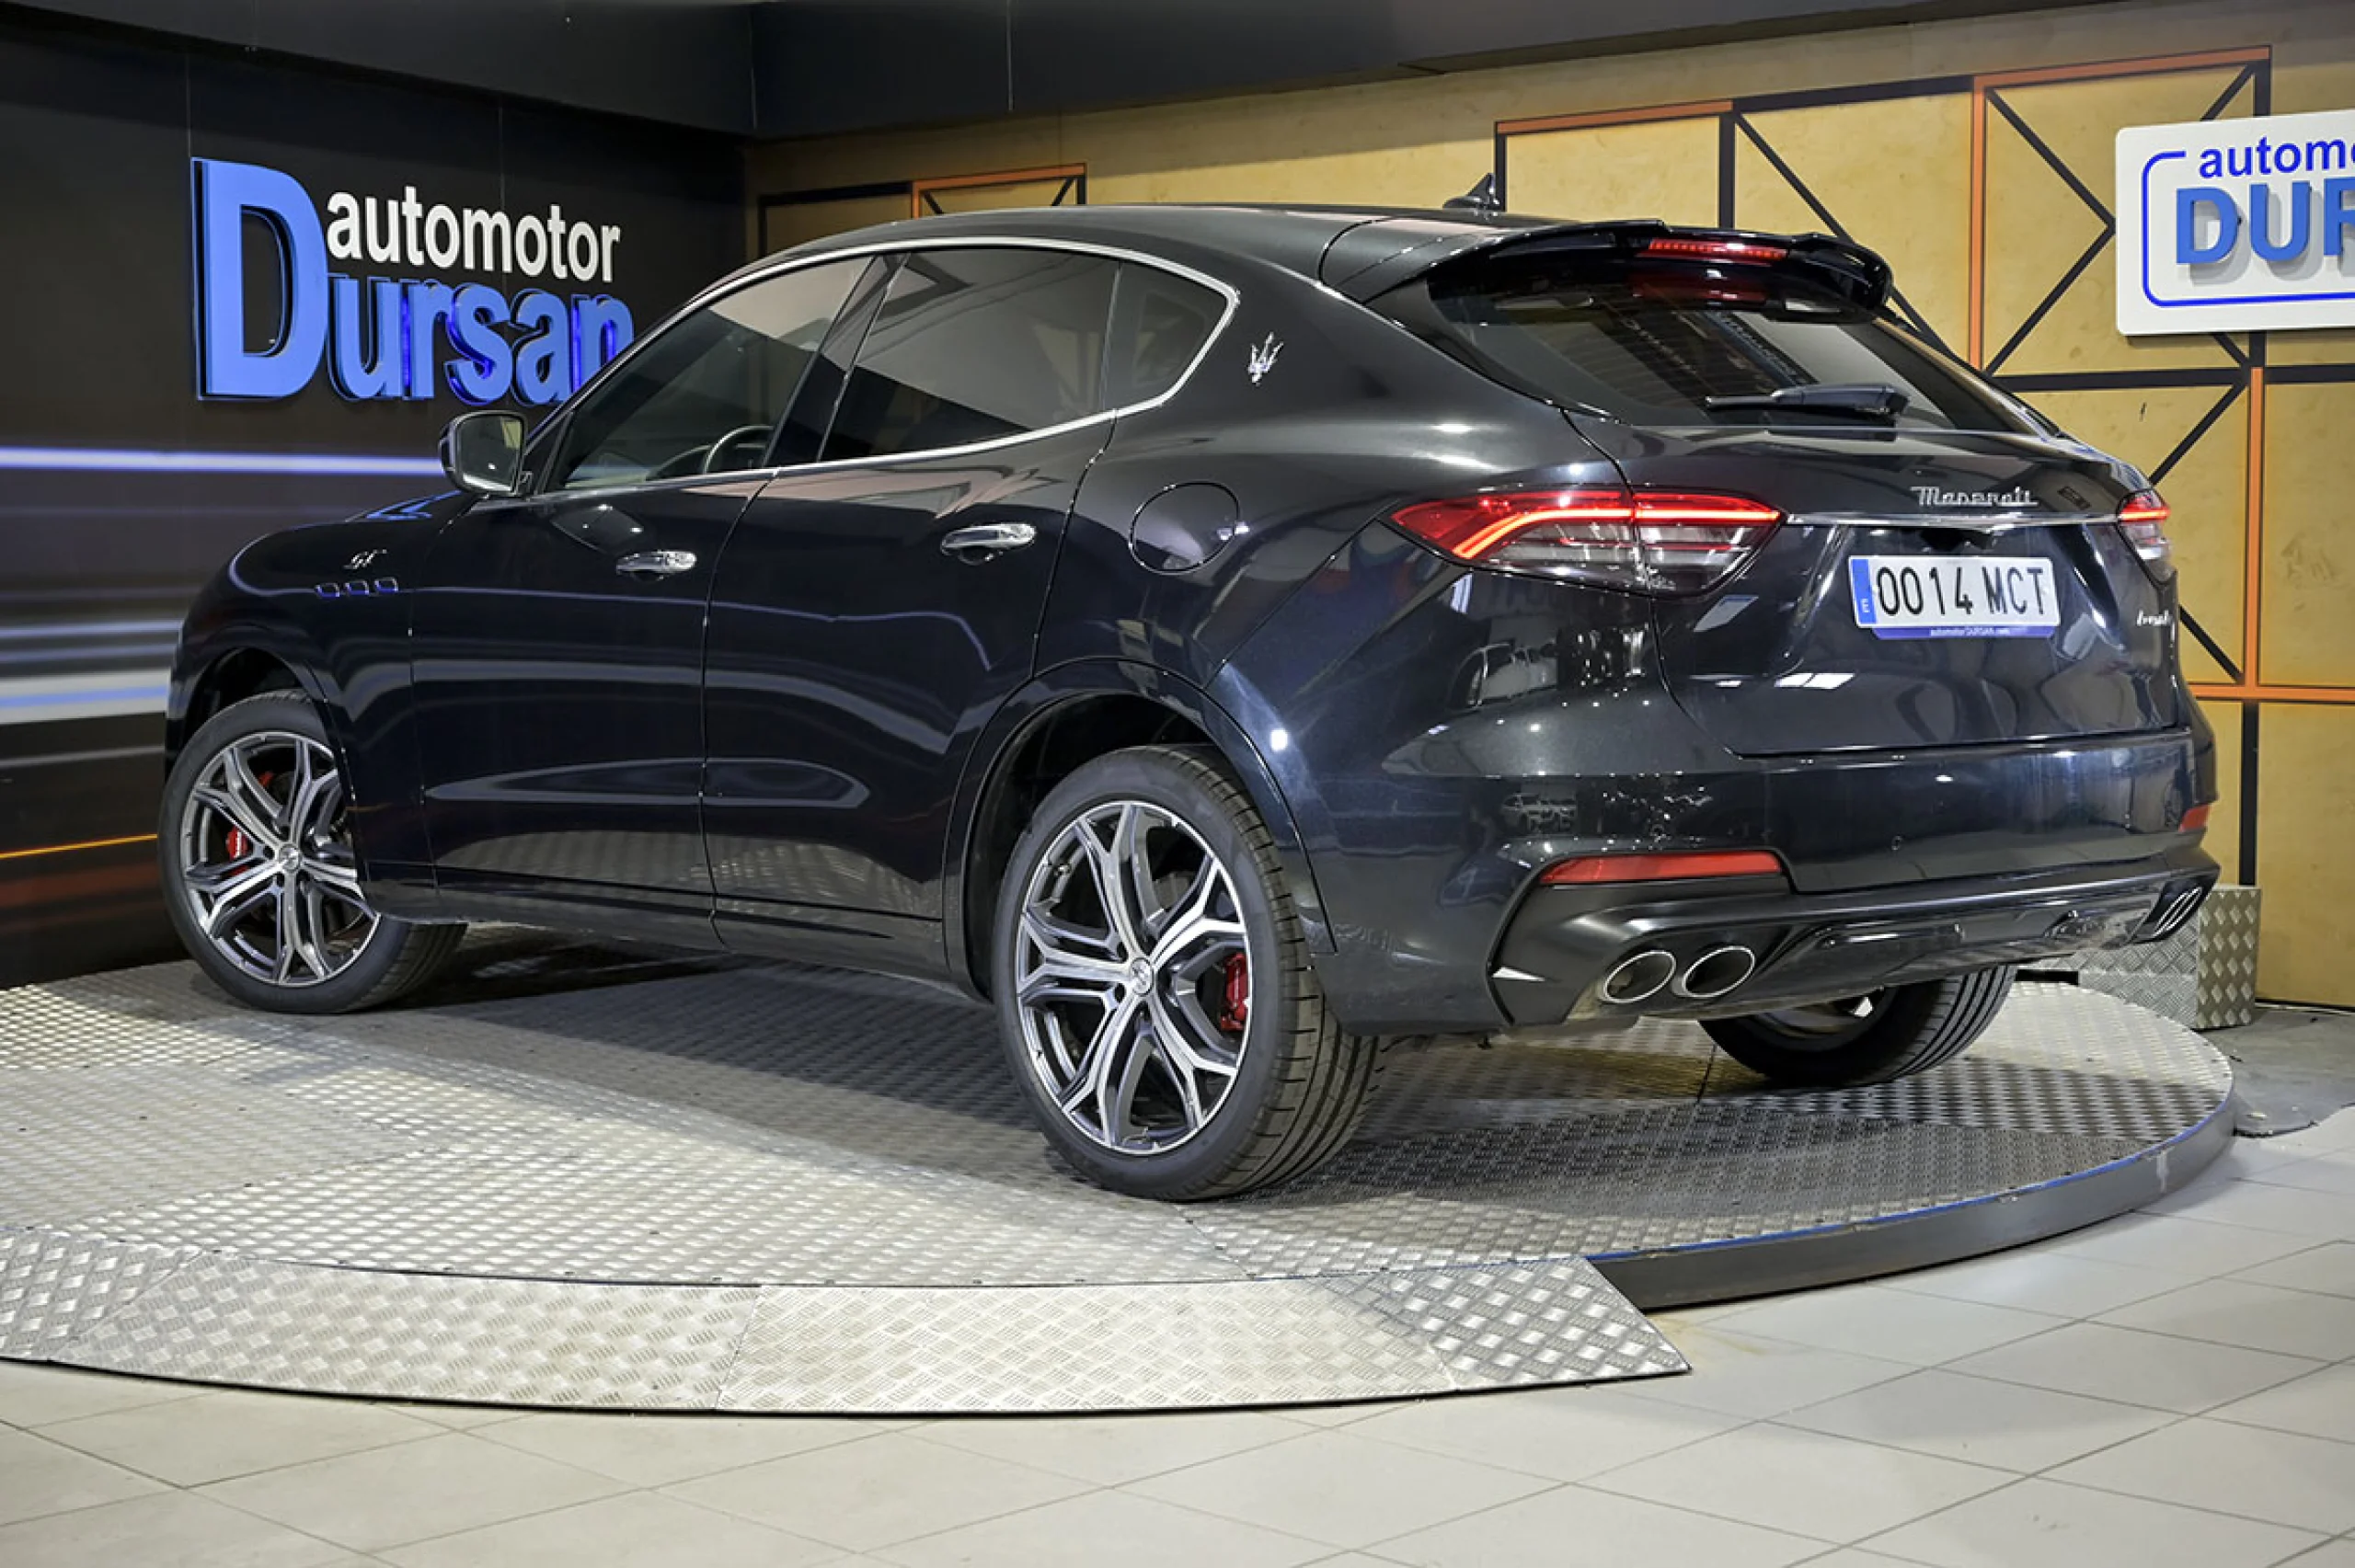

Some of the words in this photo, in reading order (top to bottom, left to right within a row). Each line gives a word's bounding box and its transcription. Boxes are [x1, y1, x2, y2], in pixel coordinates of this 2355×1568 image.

[2199, 136, 2355, 178] autom
[327, 186, 621, 283] automotor
[190, 156, 635, 406] Dursan
[1910, 486, 2039, 507] Maserati
[1860, 598, 1871, 613] E
[1876, 567, 1973, 616] 0014
[1982, 566, 2044, 615] MCT
